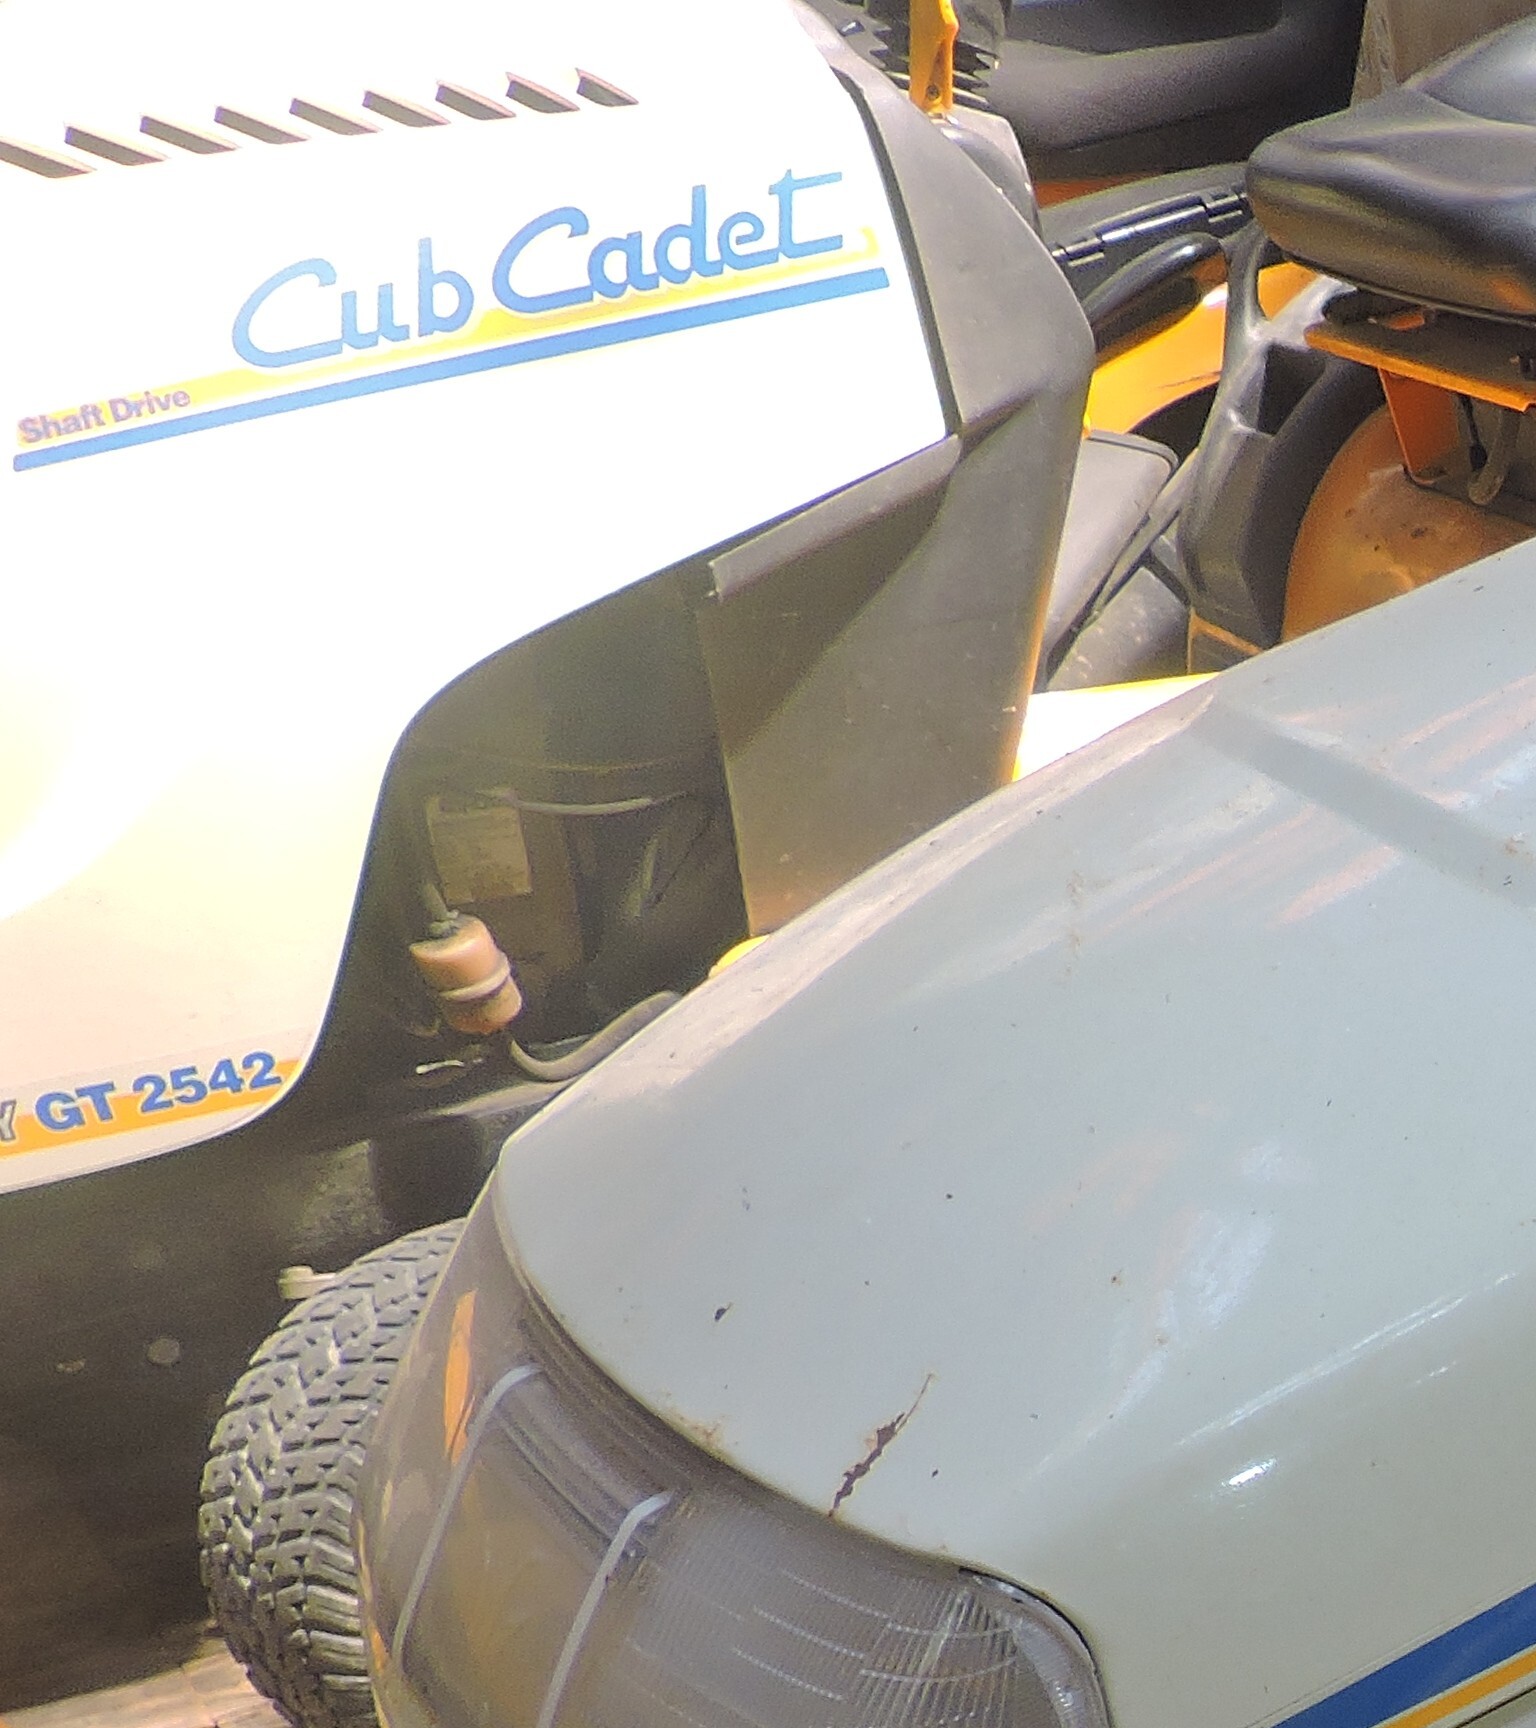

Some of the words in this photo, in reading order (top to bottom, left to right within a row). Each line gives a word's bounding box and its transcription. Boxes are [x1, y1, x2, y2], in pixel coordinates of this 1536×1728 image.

[232, 238, 475, 368] Cub
[490, 168, 843, 314] Cadet
[17, 400, 104, 446] Shaft
[109, 385, 191, 426] Drive
[35, 1081, 116, 1132] GT
[132, 1051, 282, 1115] 2542
